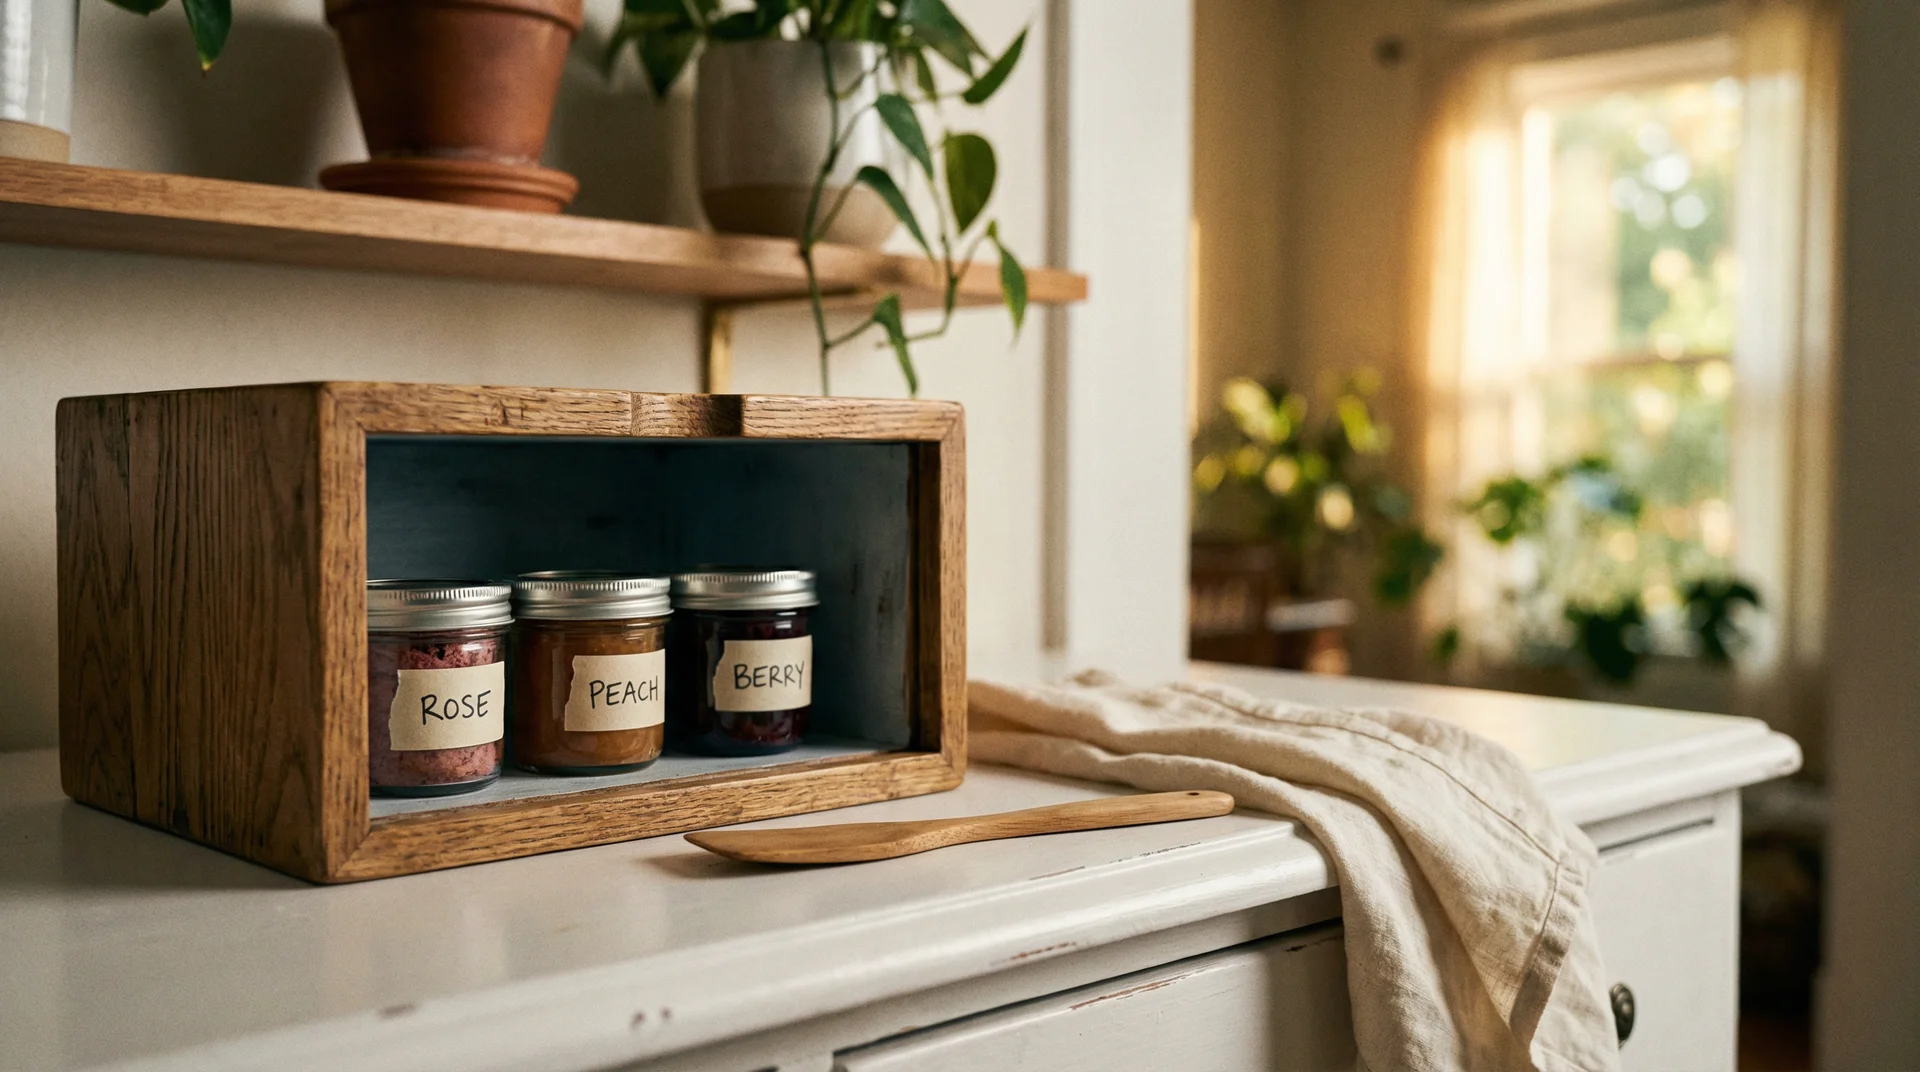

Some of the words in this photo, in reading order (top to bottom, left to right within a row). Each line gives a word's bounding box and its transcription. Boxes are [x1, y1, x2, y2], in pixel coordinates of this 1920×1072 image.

[588, 675, 659, 709] PEACH
[733, 660, 806, 690] BERRY
[420, 689, 492, 725] ROSE
